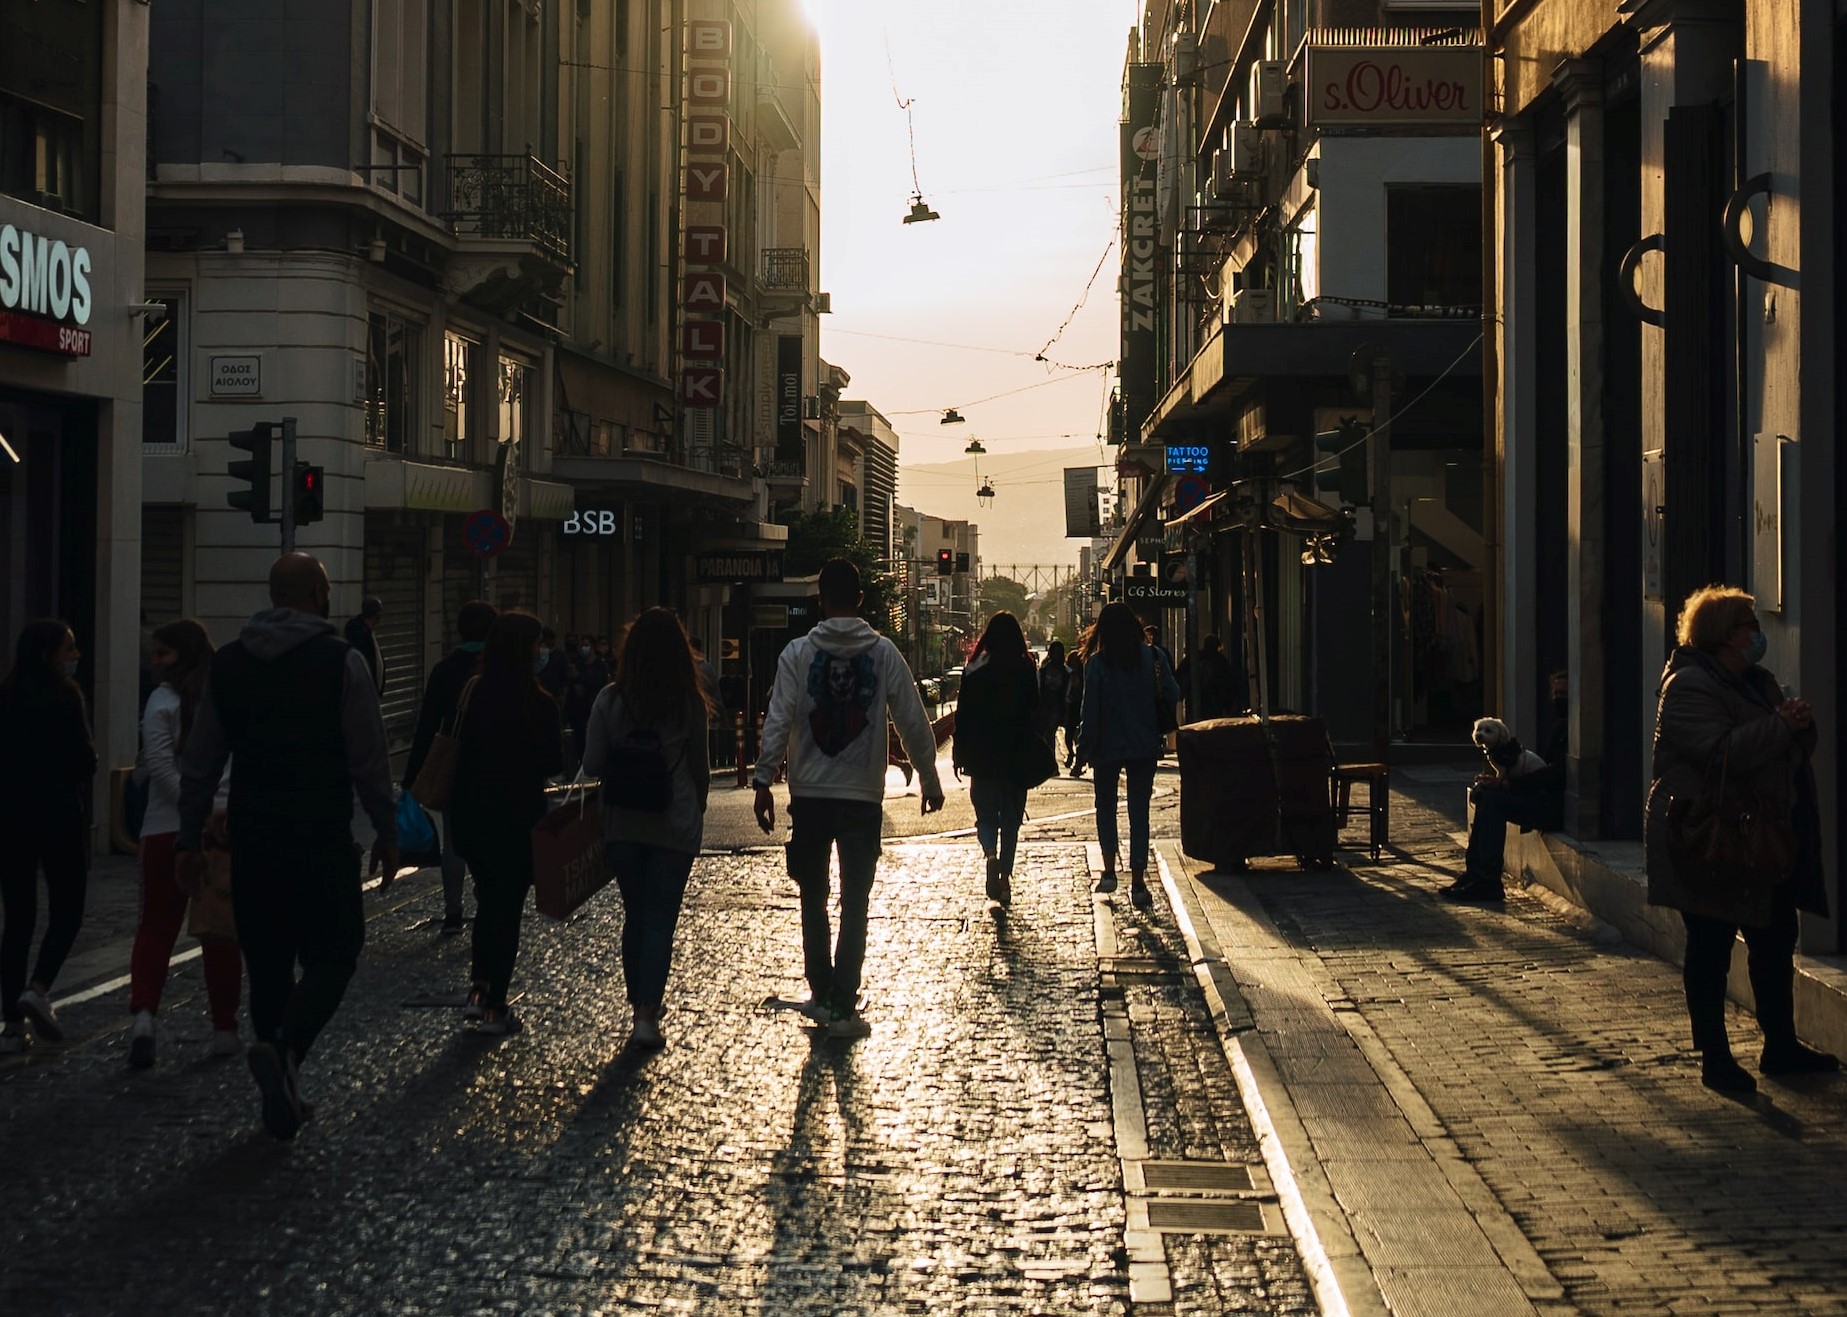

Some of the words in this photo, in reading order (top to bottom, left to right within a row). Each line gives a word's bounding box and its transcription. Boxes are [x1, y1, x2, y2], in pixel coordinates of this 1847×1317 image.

[1324, 60, 1470, 112] s.Oliver
[691, 26, 724, 193] BODY
[1132, 175, 1154, 333] ZAKCRET
[0, 224, 91, 325] SMOS
[685, 233, 720, 399] TALK
[60, 327, 90, 354] SPORT
[215, 377, 257, 386] ΑΙΟΛΟΥ
[221, 365, 250, 374] ΟΔΟΣ
[781, 373, 798, 398] moi
[780, 404, 798, 426] Toi
[1167, 446, 1209, 457] TATTOO
[563, 510, 617, 535] BSB
[1128, 586, 1145, 597] CG
[1147, 586, 1187, 598] Stores
